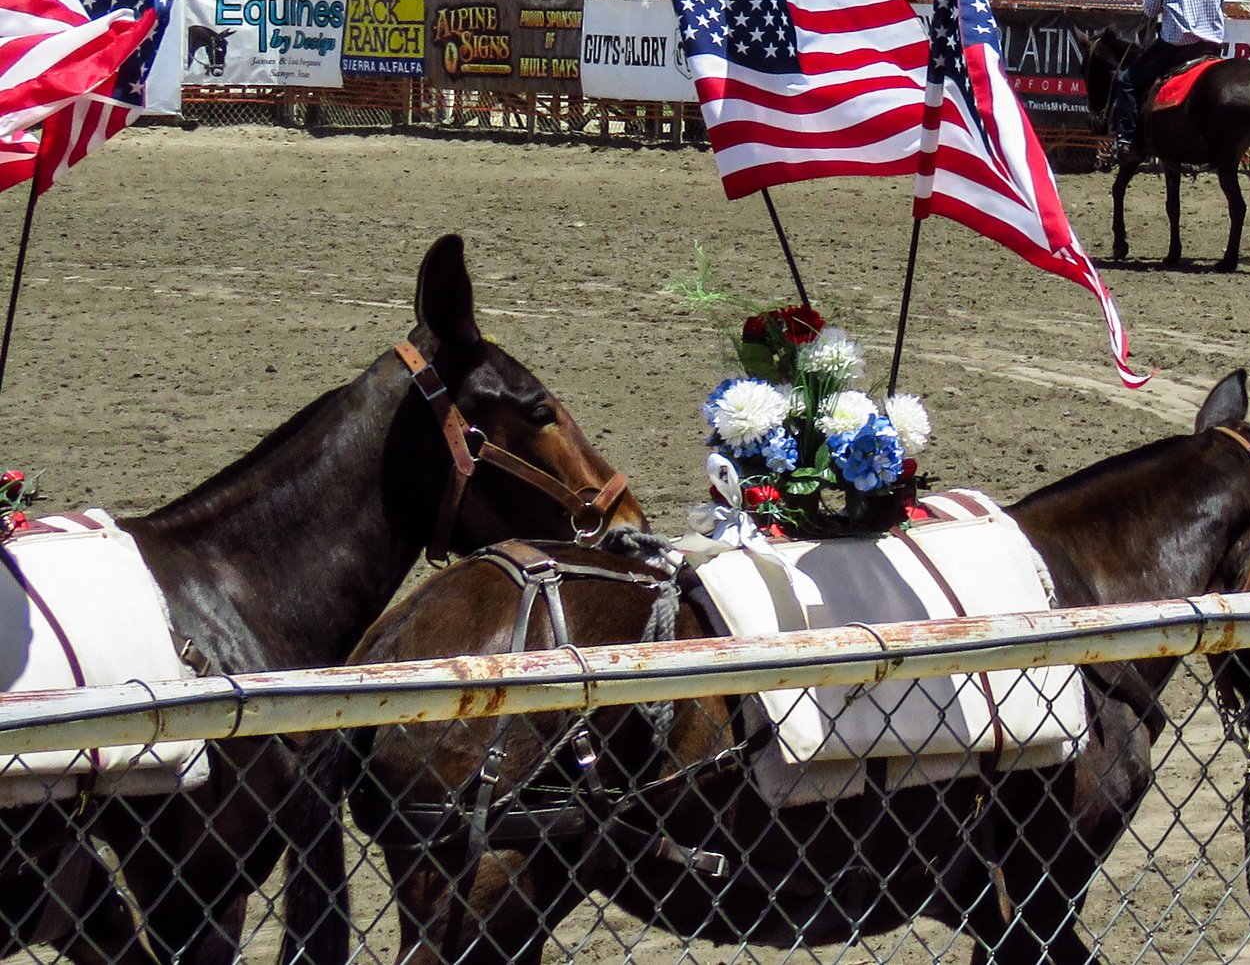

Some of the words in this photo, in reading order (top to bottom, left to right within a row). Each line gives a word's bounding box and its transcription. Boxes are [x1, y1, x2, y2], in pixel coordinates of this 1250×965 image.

[433, 7, 498, 41] ALPINE
[519, 9, 545, 27] PROUD
[546, 10, 582, 28] SPONSOR
[270, 28, 291, 55] by
[293, 29, 336, 56] Design
[347, 25, 421, 54] RANCH
[460, 30, 510, 62] SIGNS
[998, 26, 1087, 74] LATIN
[342, 59, 377, 72] SIERRA
[379, 61, 423, 74] ALFALFA
[519, 57, 547, 77] MULE
[552, 58, 579, 78] DAYS
[1006, 78, 1080, 92] RFORM
